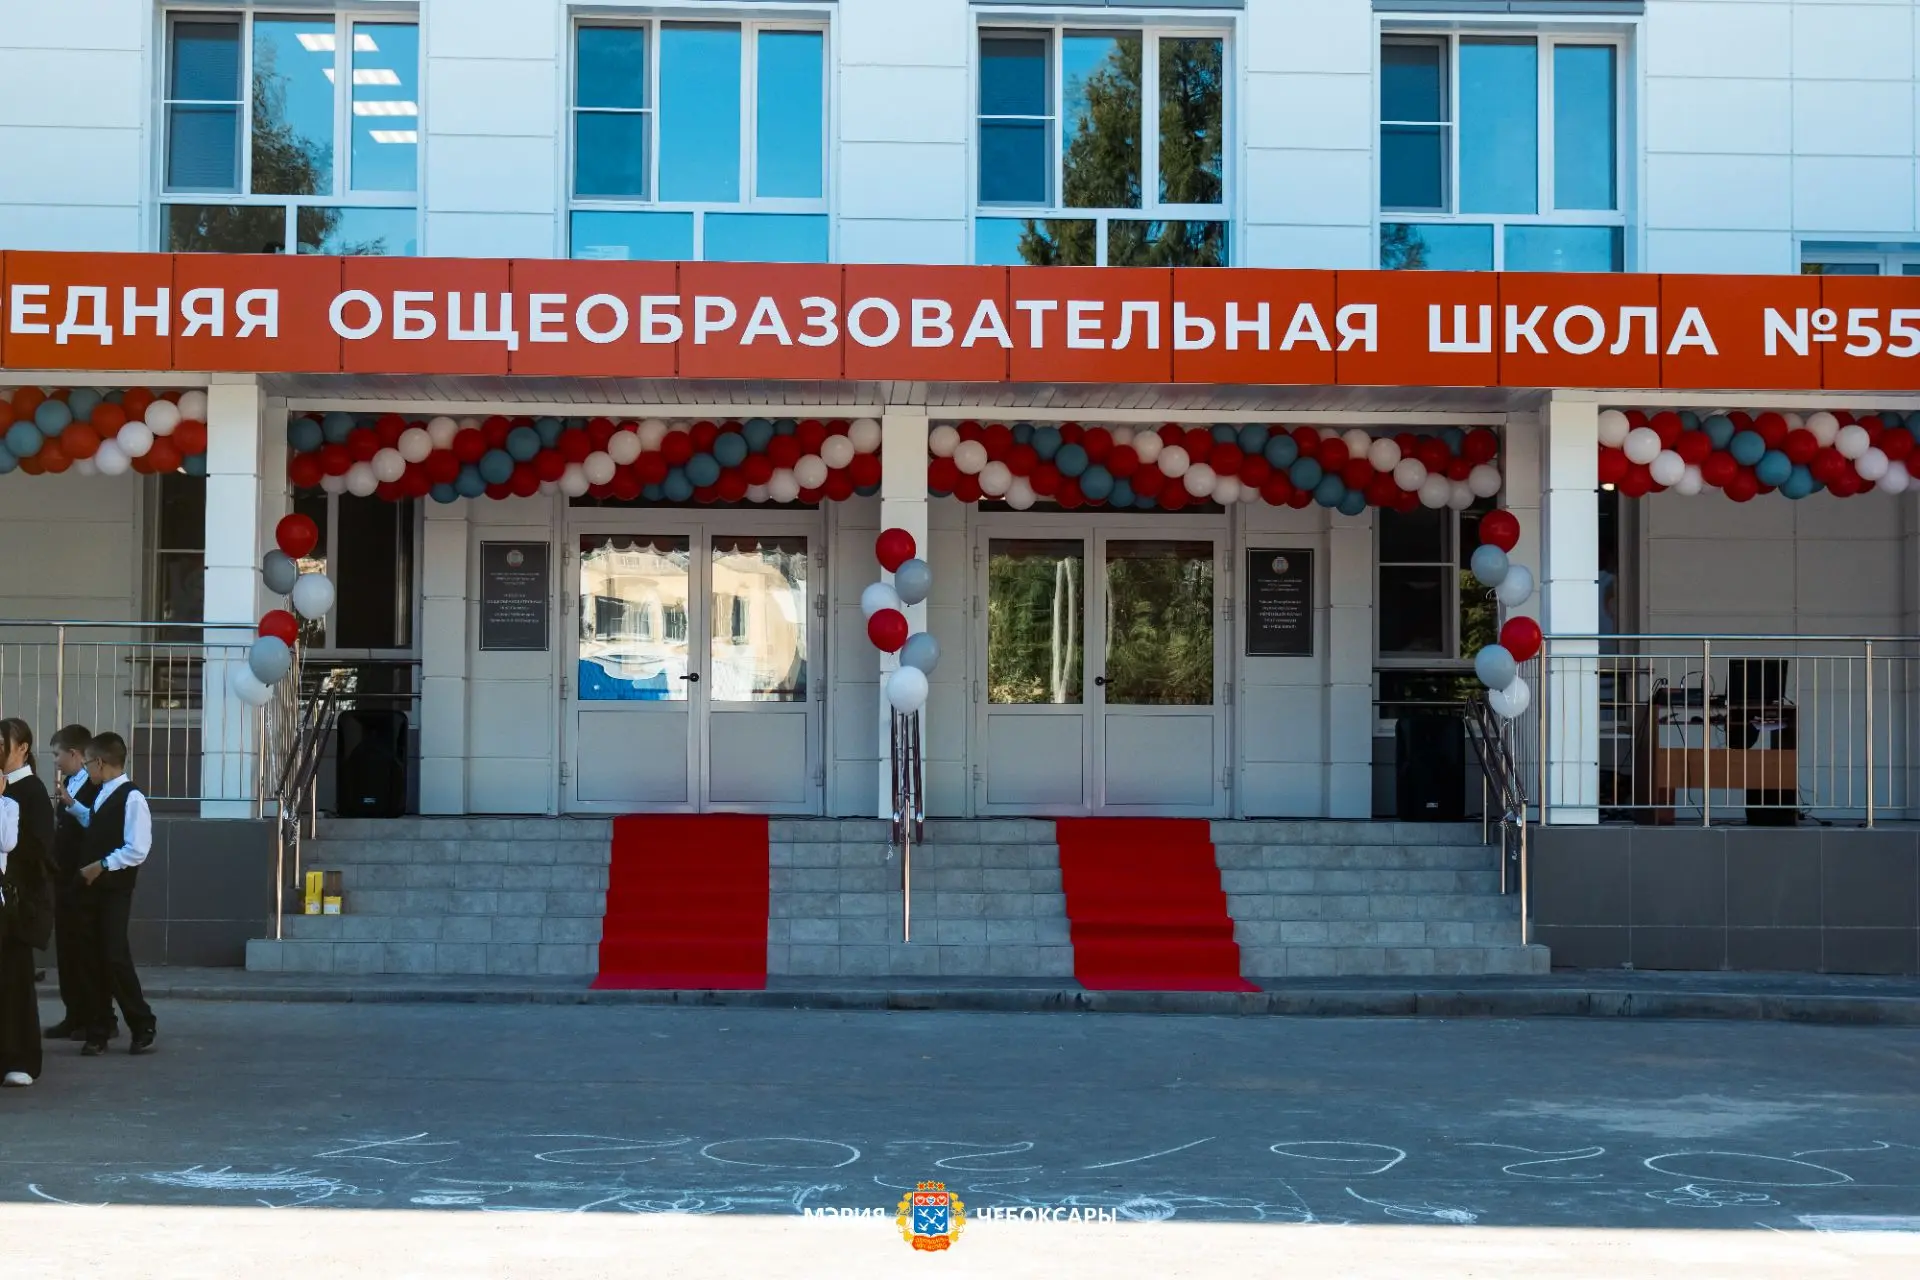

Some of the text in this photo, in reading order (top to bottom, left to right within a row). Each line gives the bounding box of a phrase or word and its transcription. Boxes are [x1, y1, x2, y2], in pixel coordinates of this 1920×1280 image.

[0, 285, 1920, 358] ЕДНЯЯ ОБЩЕОБРАЗОВАТЕЛЬНАЯ ШКОЛА №55
